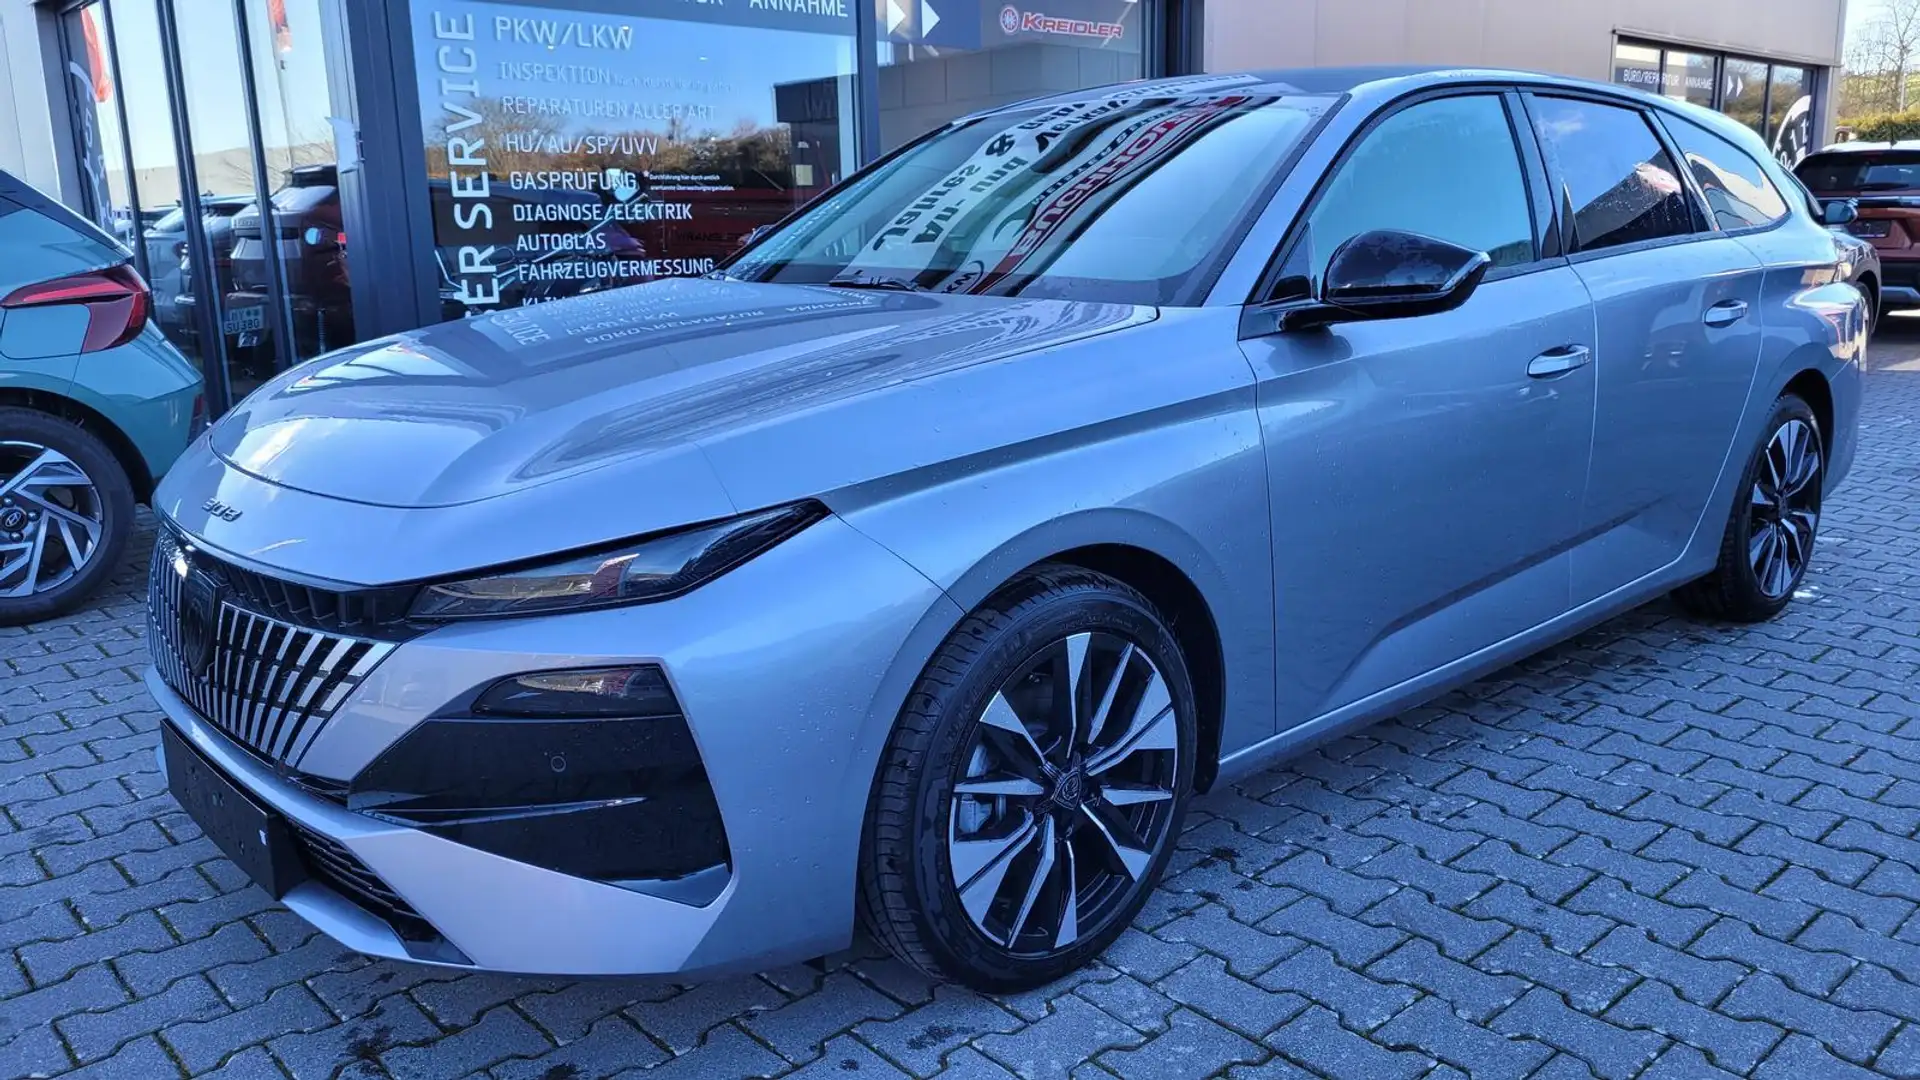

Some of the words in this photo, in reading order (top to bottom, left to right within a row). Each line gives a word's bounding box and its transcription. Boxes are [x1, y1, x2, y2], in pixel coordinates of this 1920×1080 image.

[494, 15, 633, 50] PKW/LKW
[1021, 11, 1124, 39] KREIDLER
[499, 61, 611, 85] INSPEKTION
[434, 11, 493, 229] SERVICE
[502, 95, 629, 119] REPARATUREN
[633, 101, 682, 121] ALLER
[687, 104, 717, 121] ART
[510, 167, 638, 191] GASPRÜFUNG
[513, 203, 693, 222] DIAGNOSE/ELEKTRIK
[516, 232, 607, 251] AUTOGLAS
[518, 258, 714, 282] FAHRZEUGVERMESSUNG
[201, 496, 244, 523] 308
